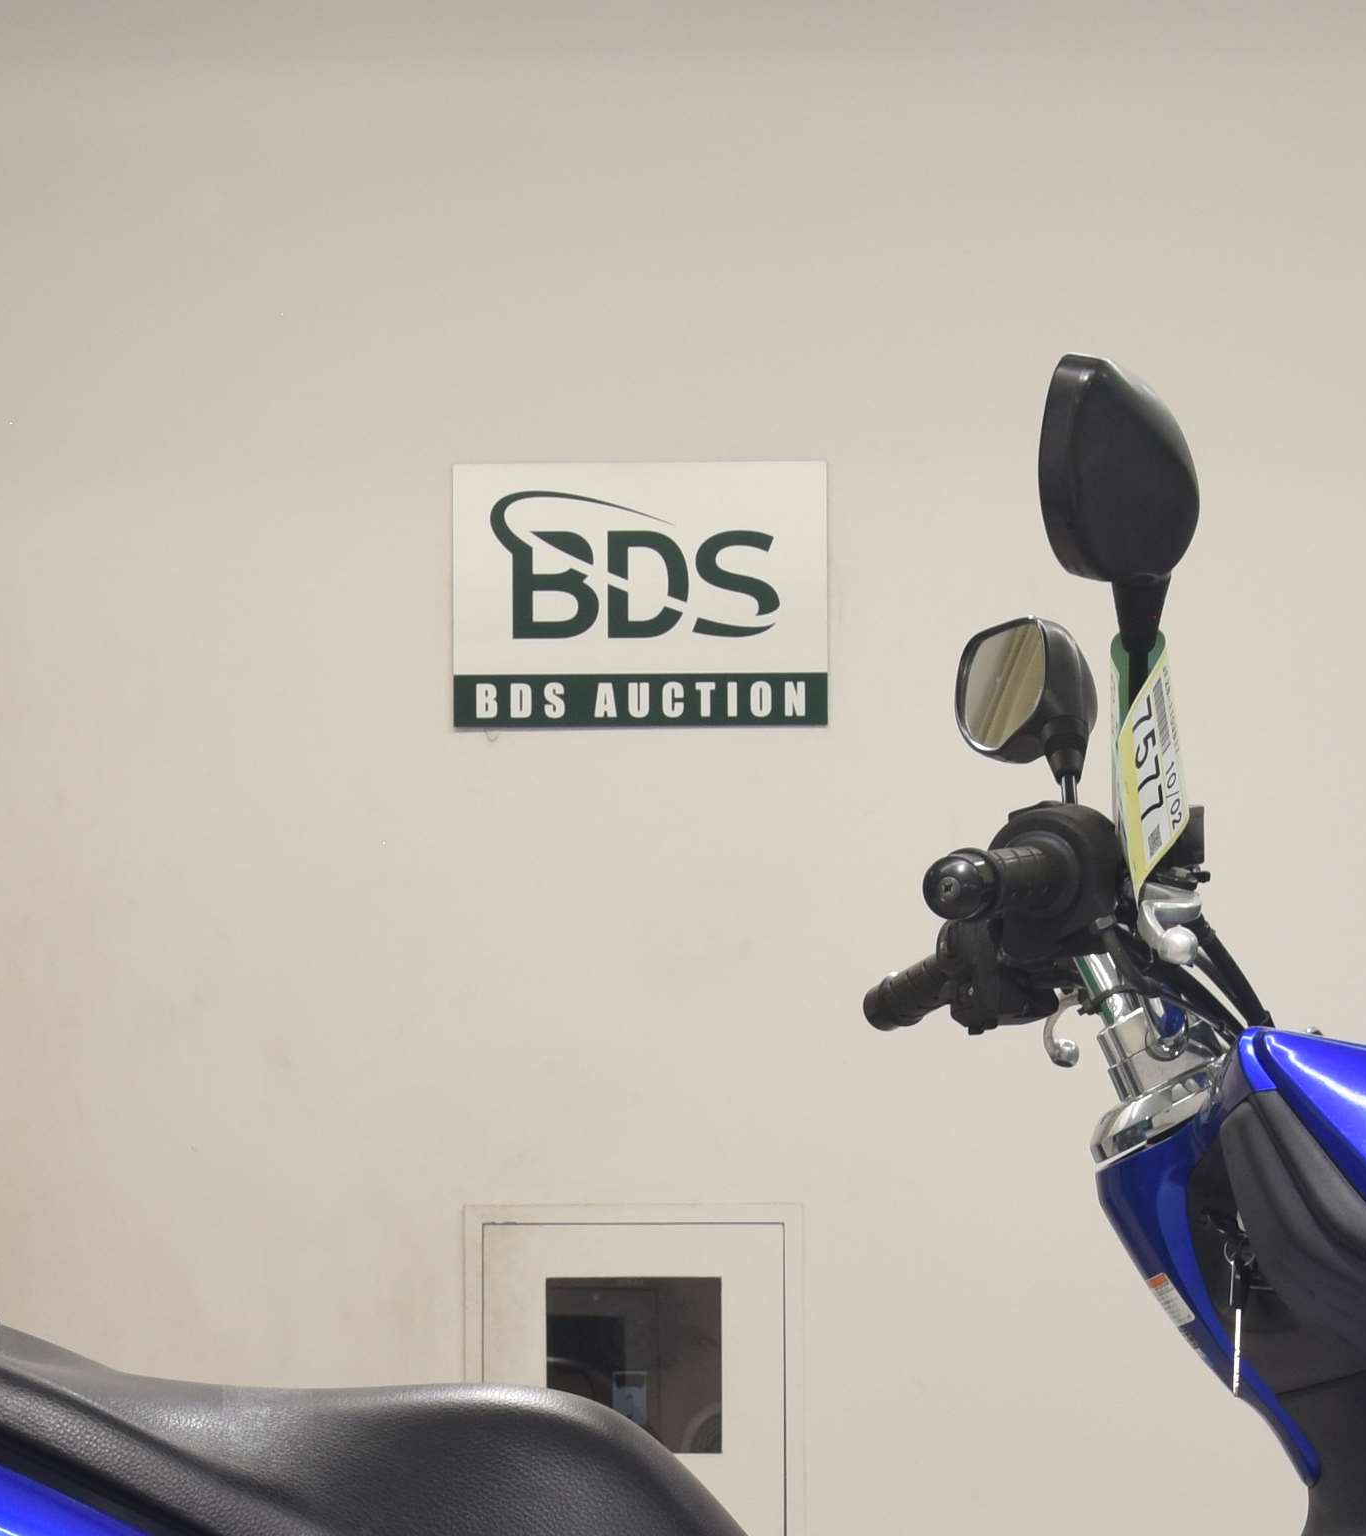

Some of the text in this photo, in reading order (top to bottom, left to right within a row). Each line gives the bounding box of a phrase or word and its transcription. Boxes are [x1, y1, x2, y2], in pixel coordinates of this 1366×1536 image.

[490, 490, 781, 639] BDS
[474, 680, 807, 720] BDS AUCTION
[1131, 694, 1164, 822] 7577
[1164, 760, 1183, 831] 10/02
